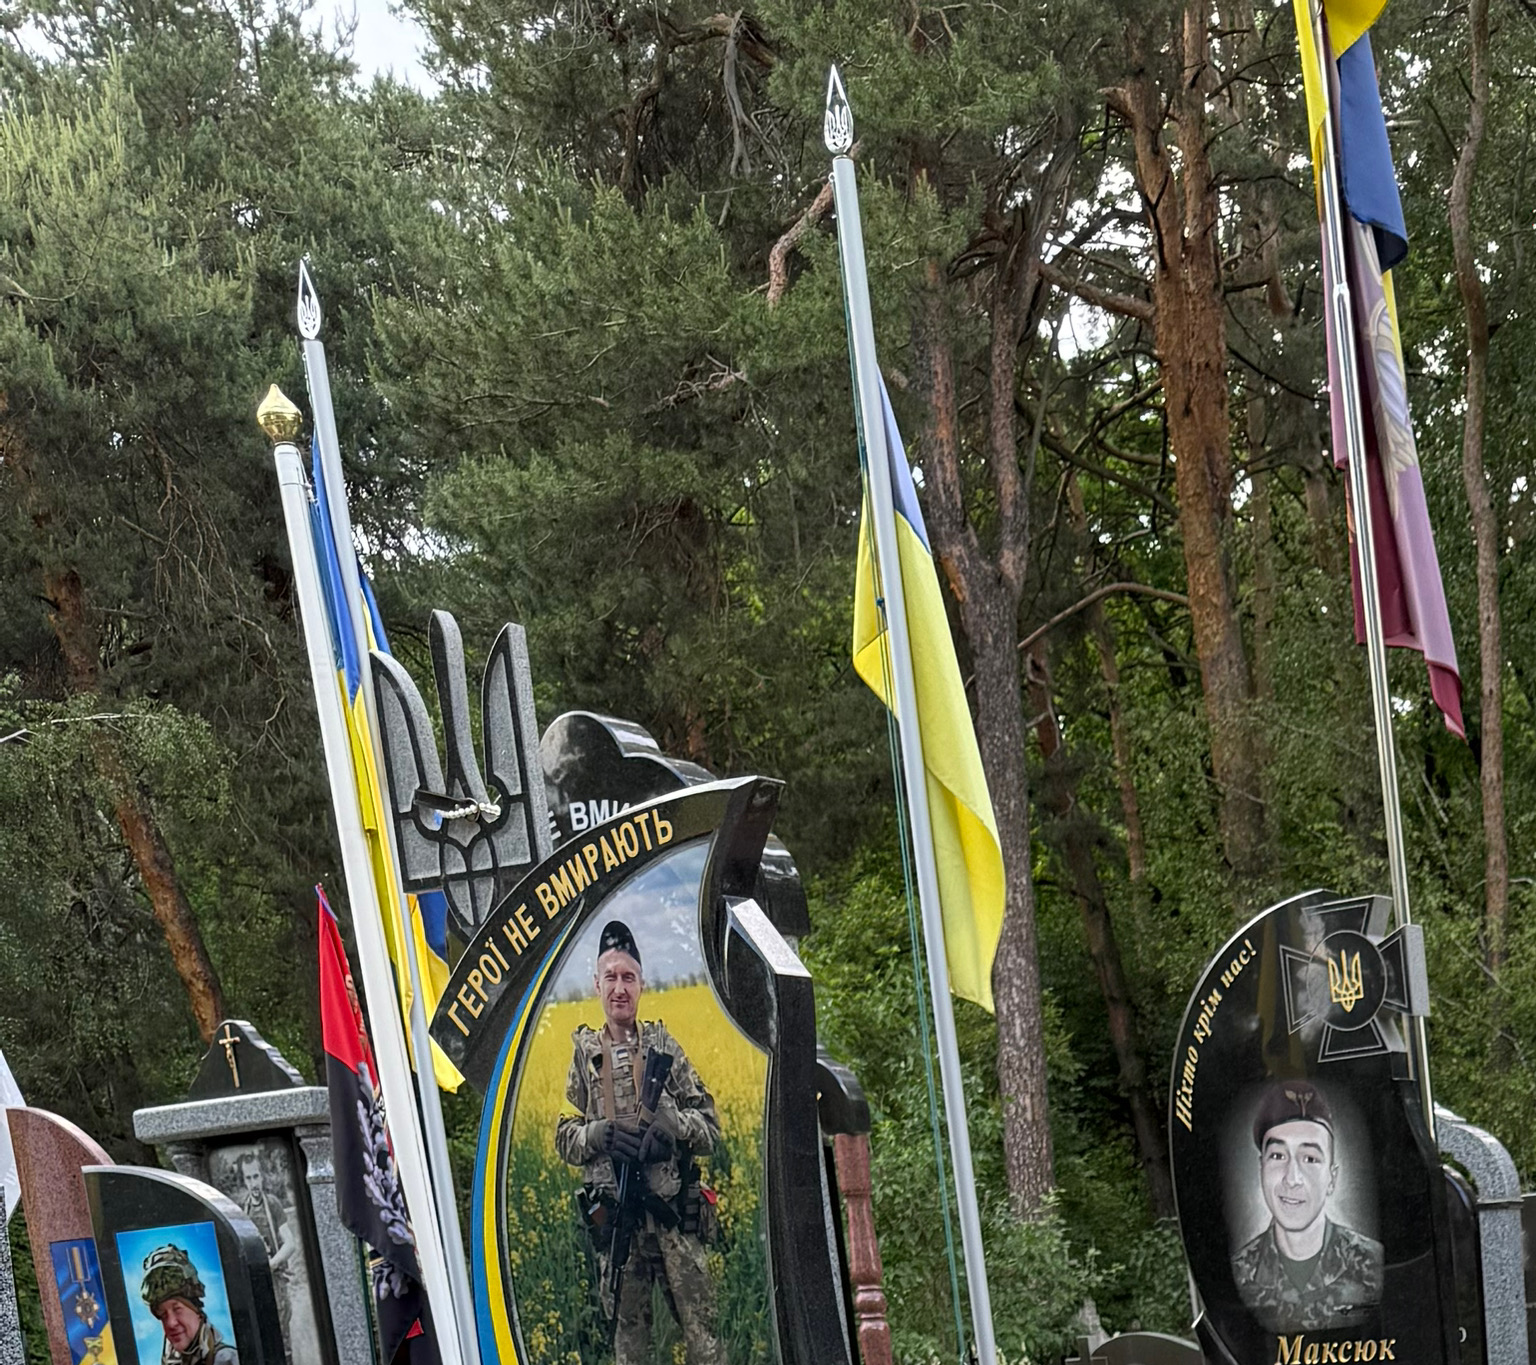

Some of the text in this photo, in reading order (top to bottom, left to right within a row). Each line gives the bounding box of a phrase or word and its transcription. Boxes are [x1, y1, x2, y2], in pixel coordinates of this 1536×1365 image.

[446, 935, 512, 1038] ГЕРОЇ
[502, 903, 542, 957] НЕ
[534, 807, 675, 921] ВМИРАЮТЬ
[1175, 937, 1258, 1133] Ніхто крім нас!
